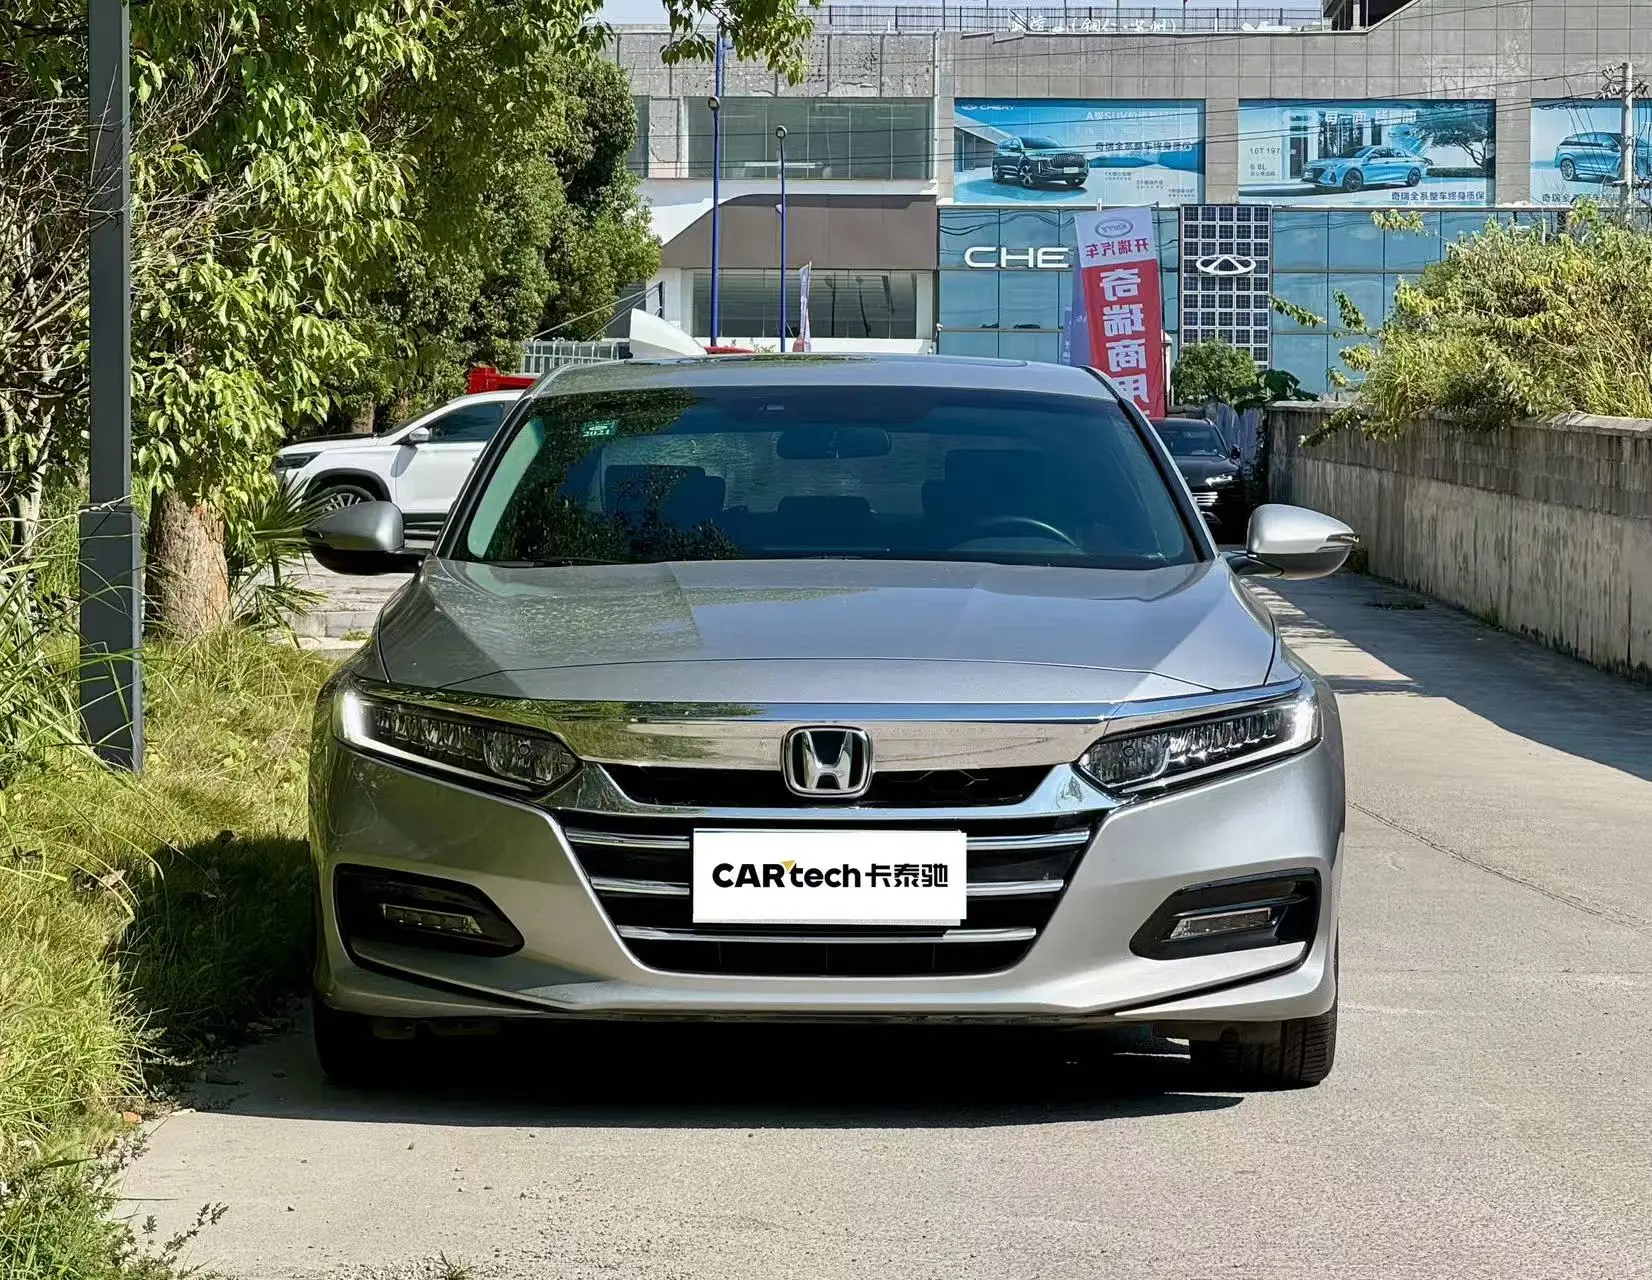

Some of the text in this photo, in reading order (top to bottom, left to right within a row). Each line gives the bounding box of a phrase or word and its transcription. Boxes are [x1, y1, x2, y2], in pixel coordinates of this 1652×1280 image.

[1391, 190, 1486, 201] 奇瑞全系整车终身质保
